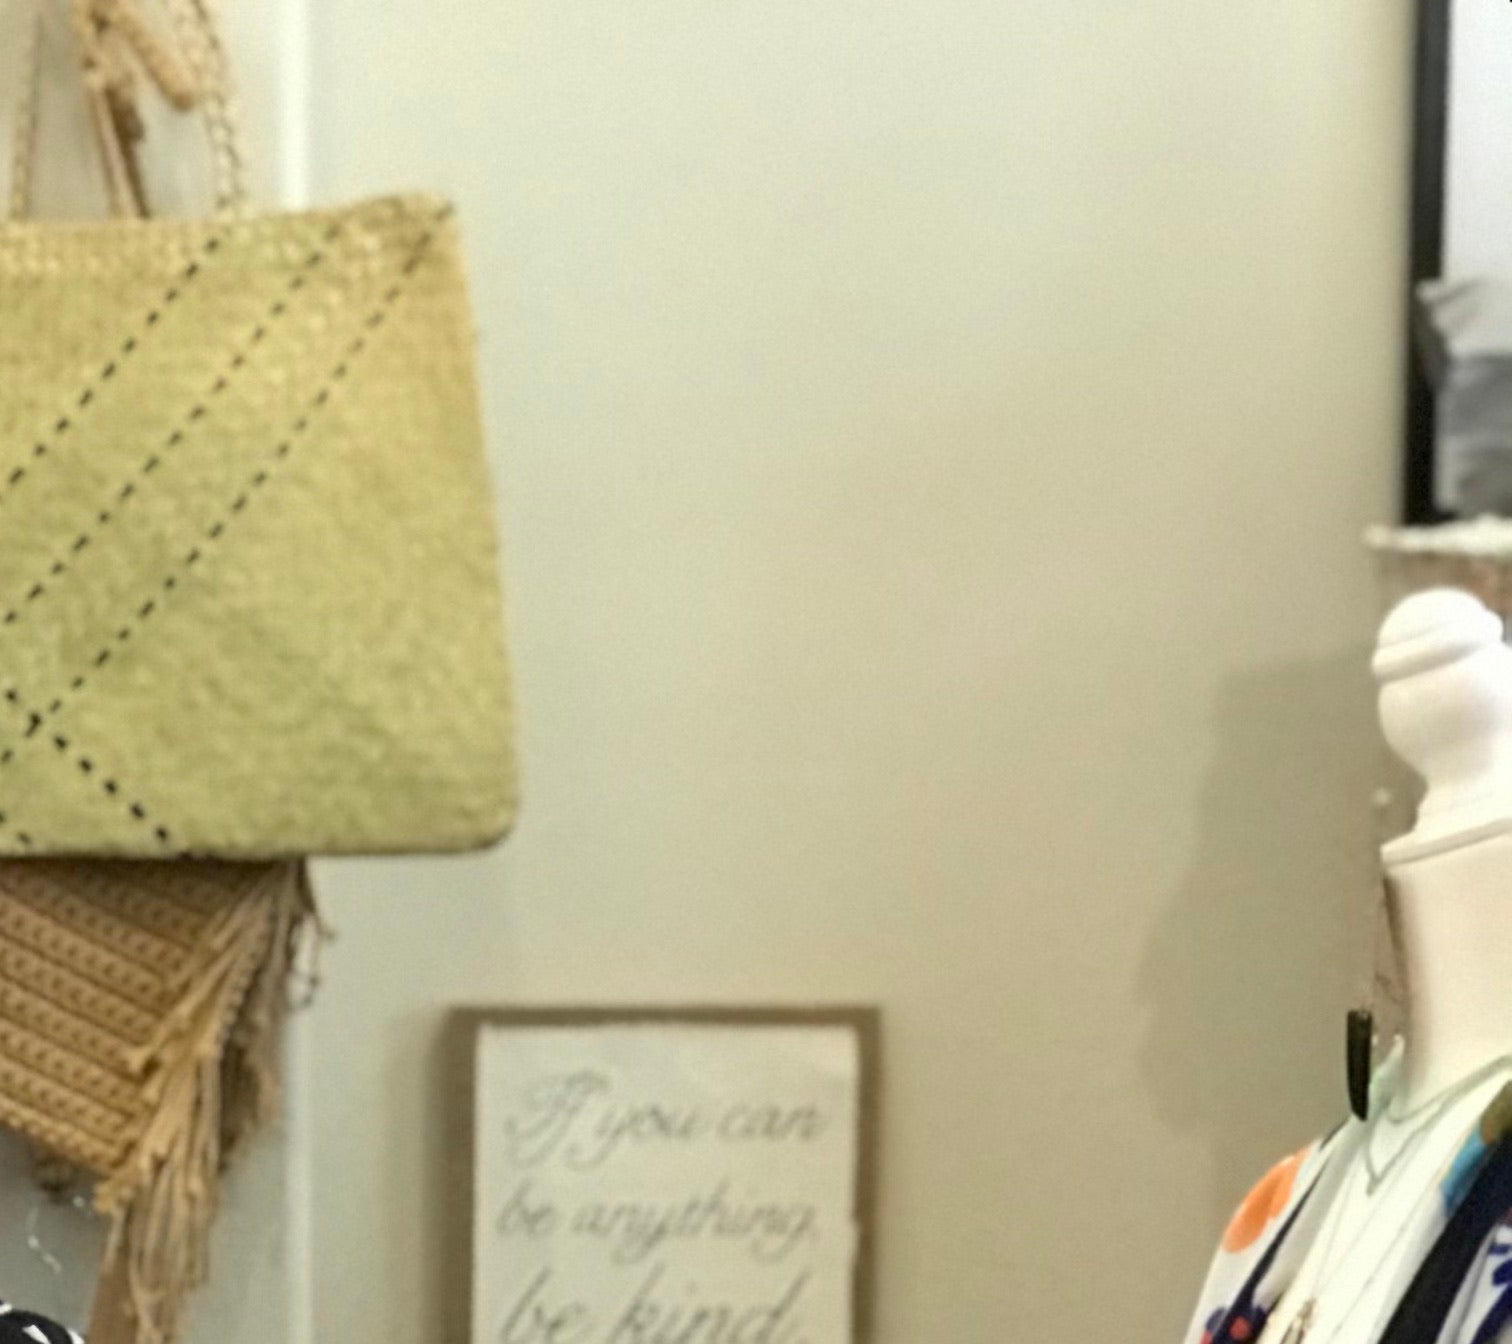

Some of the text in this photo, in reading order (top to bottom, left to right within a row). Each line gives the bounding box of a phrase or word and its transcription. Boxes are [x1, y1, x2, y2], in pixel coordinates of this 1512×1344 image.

[565, 1104, 700, 1171] you
[719, 1103, 826, 1142] can
[496, 1179, 554, 1238] be
